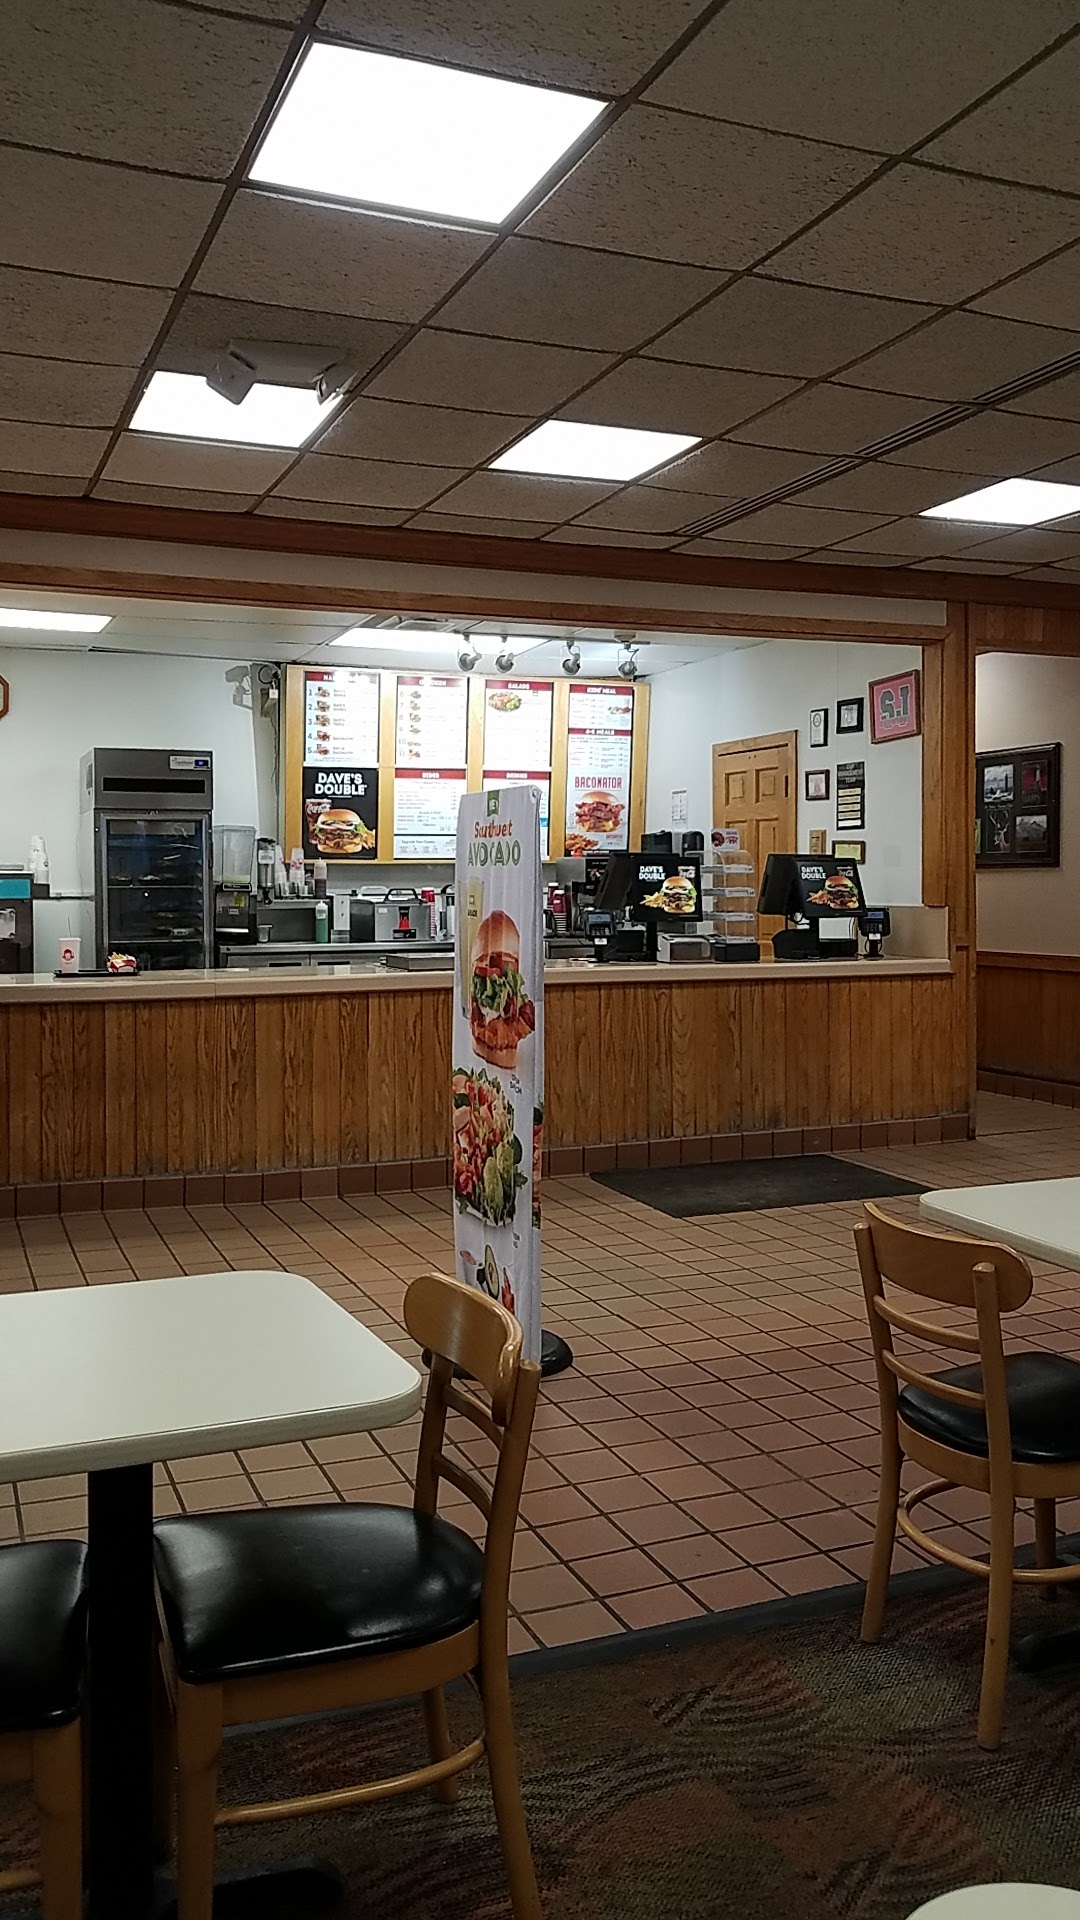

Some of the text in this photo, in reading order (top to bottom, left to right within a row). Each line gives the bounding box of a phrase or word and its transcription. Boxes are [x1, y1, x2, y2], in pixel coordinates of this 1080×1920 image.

[307, 703, 313, 711] 2
[307, 718, 313, 726] 3
[307, 732, 313, 740] 4
[307, 746, 313, 754] 5
[317, 772, 363, 785] DAVE'S
[574, 776, 623, 789] BACONATOR
[314, 783, 365, 796] DOUBLE
[639, 865, 664, 873] DAVE'S
[638, 872, 667, 880] DOUBLE
[801, 872, 827, 880] DOUBLE
